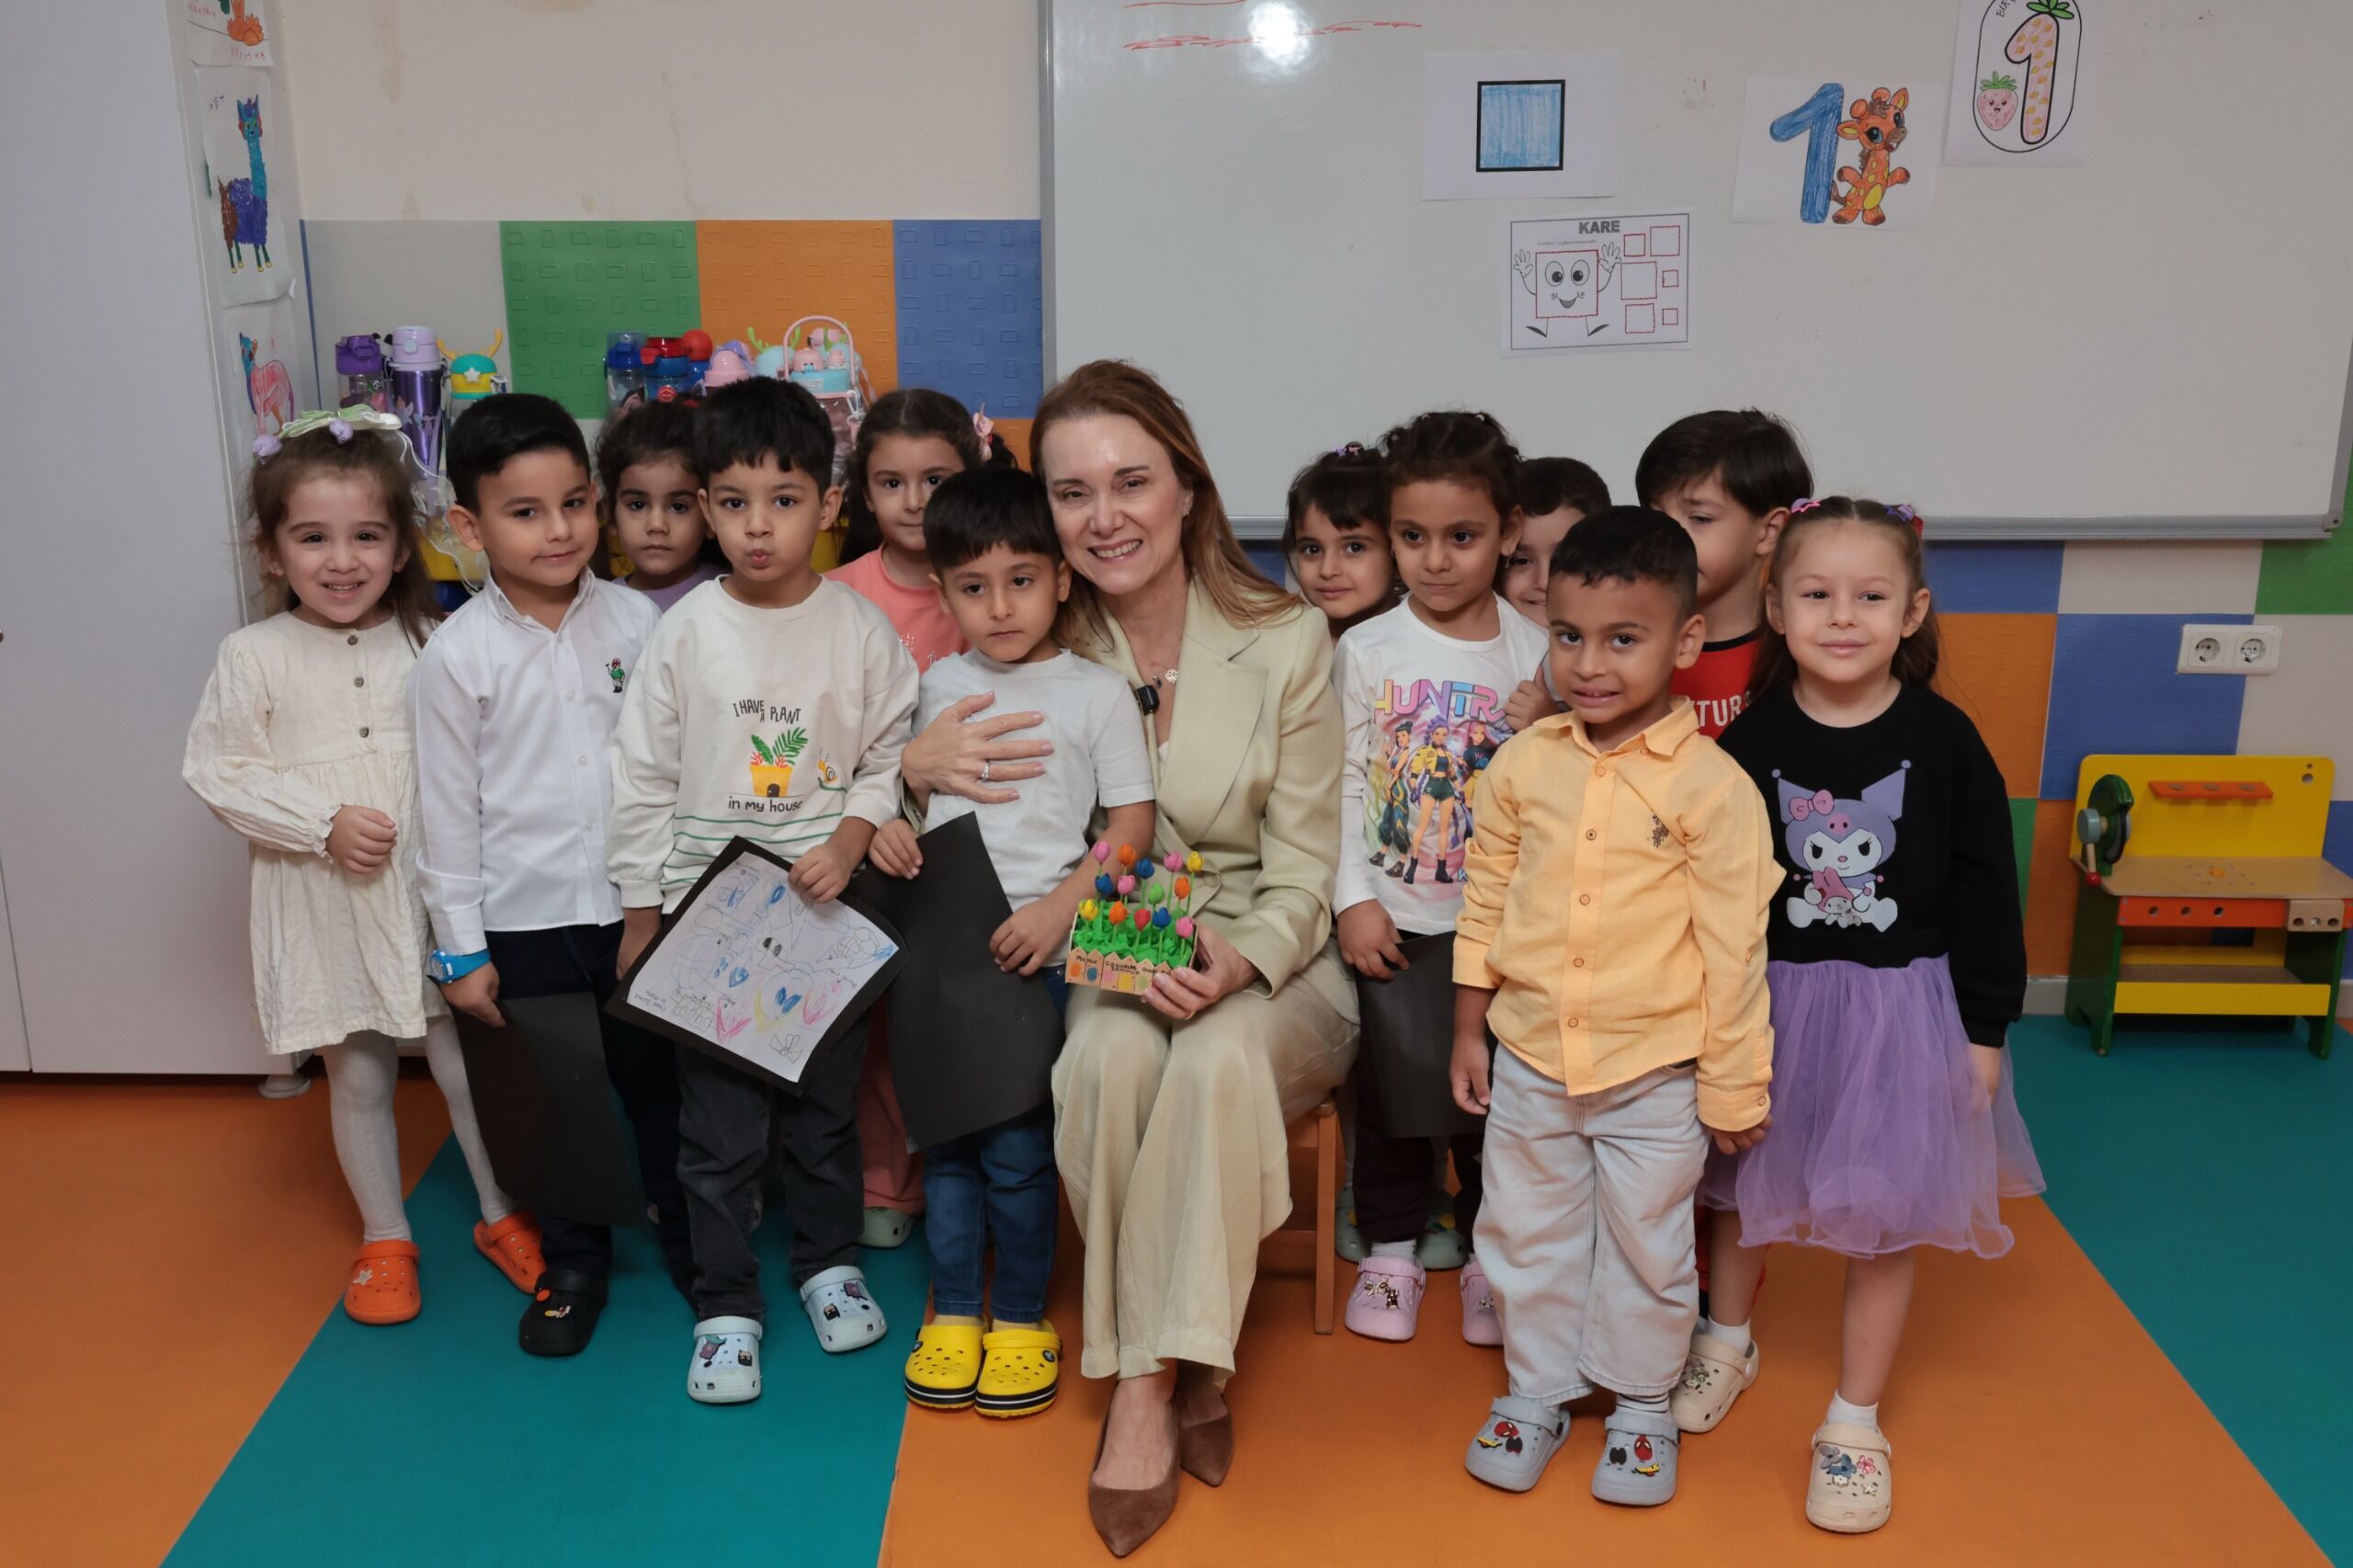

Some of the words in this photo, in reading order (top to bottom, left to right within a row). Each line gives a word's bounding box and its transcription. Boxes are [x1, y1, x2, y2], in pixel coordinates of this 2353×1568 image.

[2005, 12, 2059, 144] 1
[1769, 83, 1845, 223] 1
[1578, 221, 1620, 234] KARE
[733, 703, 740, 717] I
[739, 699, 765, 714] HAVE
[760, 712, 765, 722] A
[770, 706, 801, 724] PLANT
[729, 795, 741, 810] in
[745, 801, 765, 812] my
[770, 799, 802, 812] house
